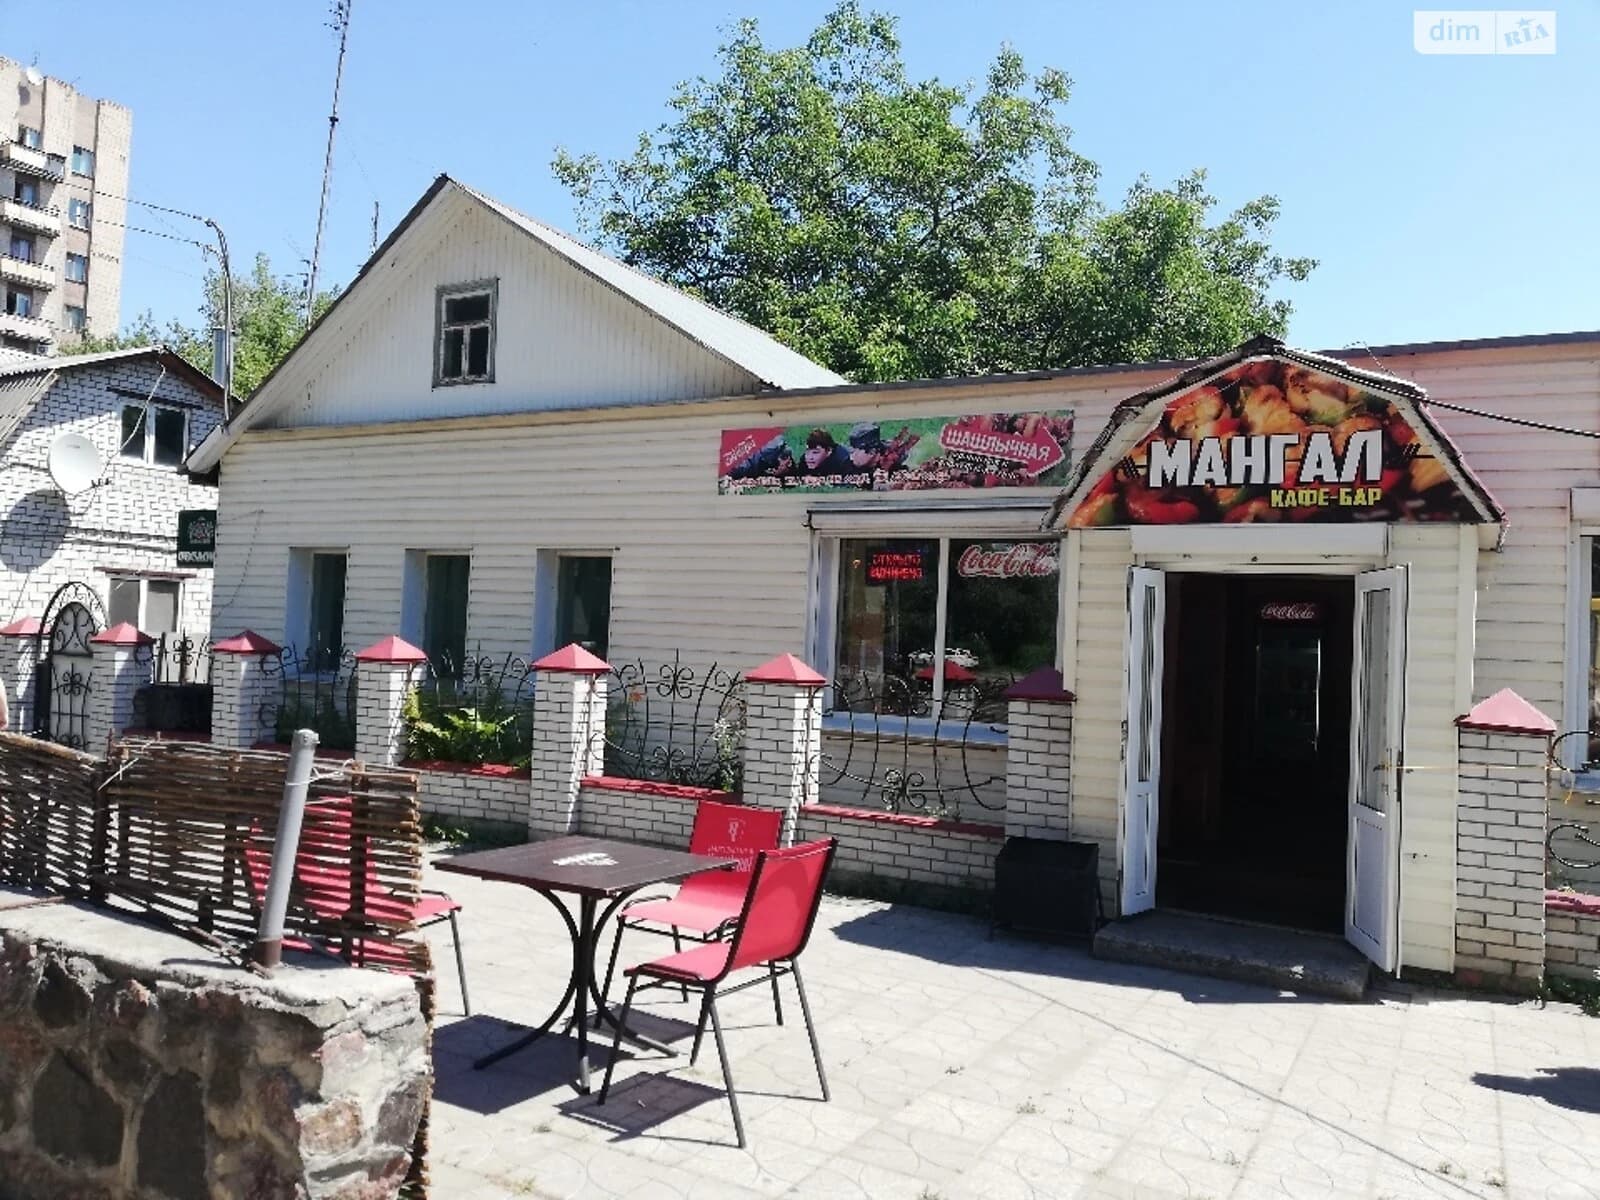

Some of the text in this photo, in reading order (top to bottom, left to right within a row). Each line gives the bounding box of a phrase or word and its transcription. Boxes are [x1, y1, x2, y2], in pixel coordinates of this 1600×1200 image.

[946, 429, 1050, 462] ШАШЛЫЧНАЯ
[1148, 429, 1383, 488] МАНГАЛ
[1270, 487, 1382, 508] КАФЕ-БАР
